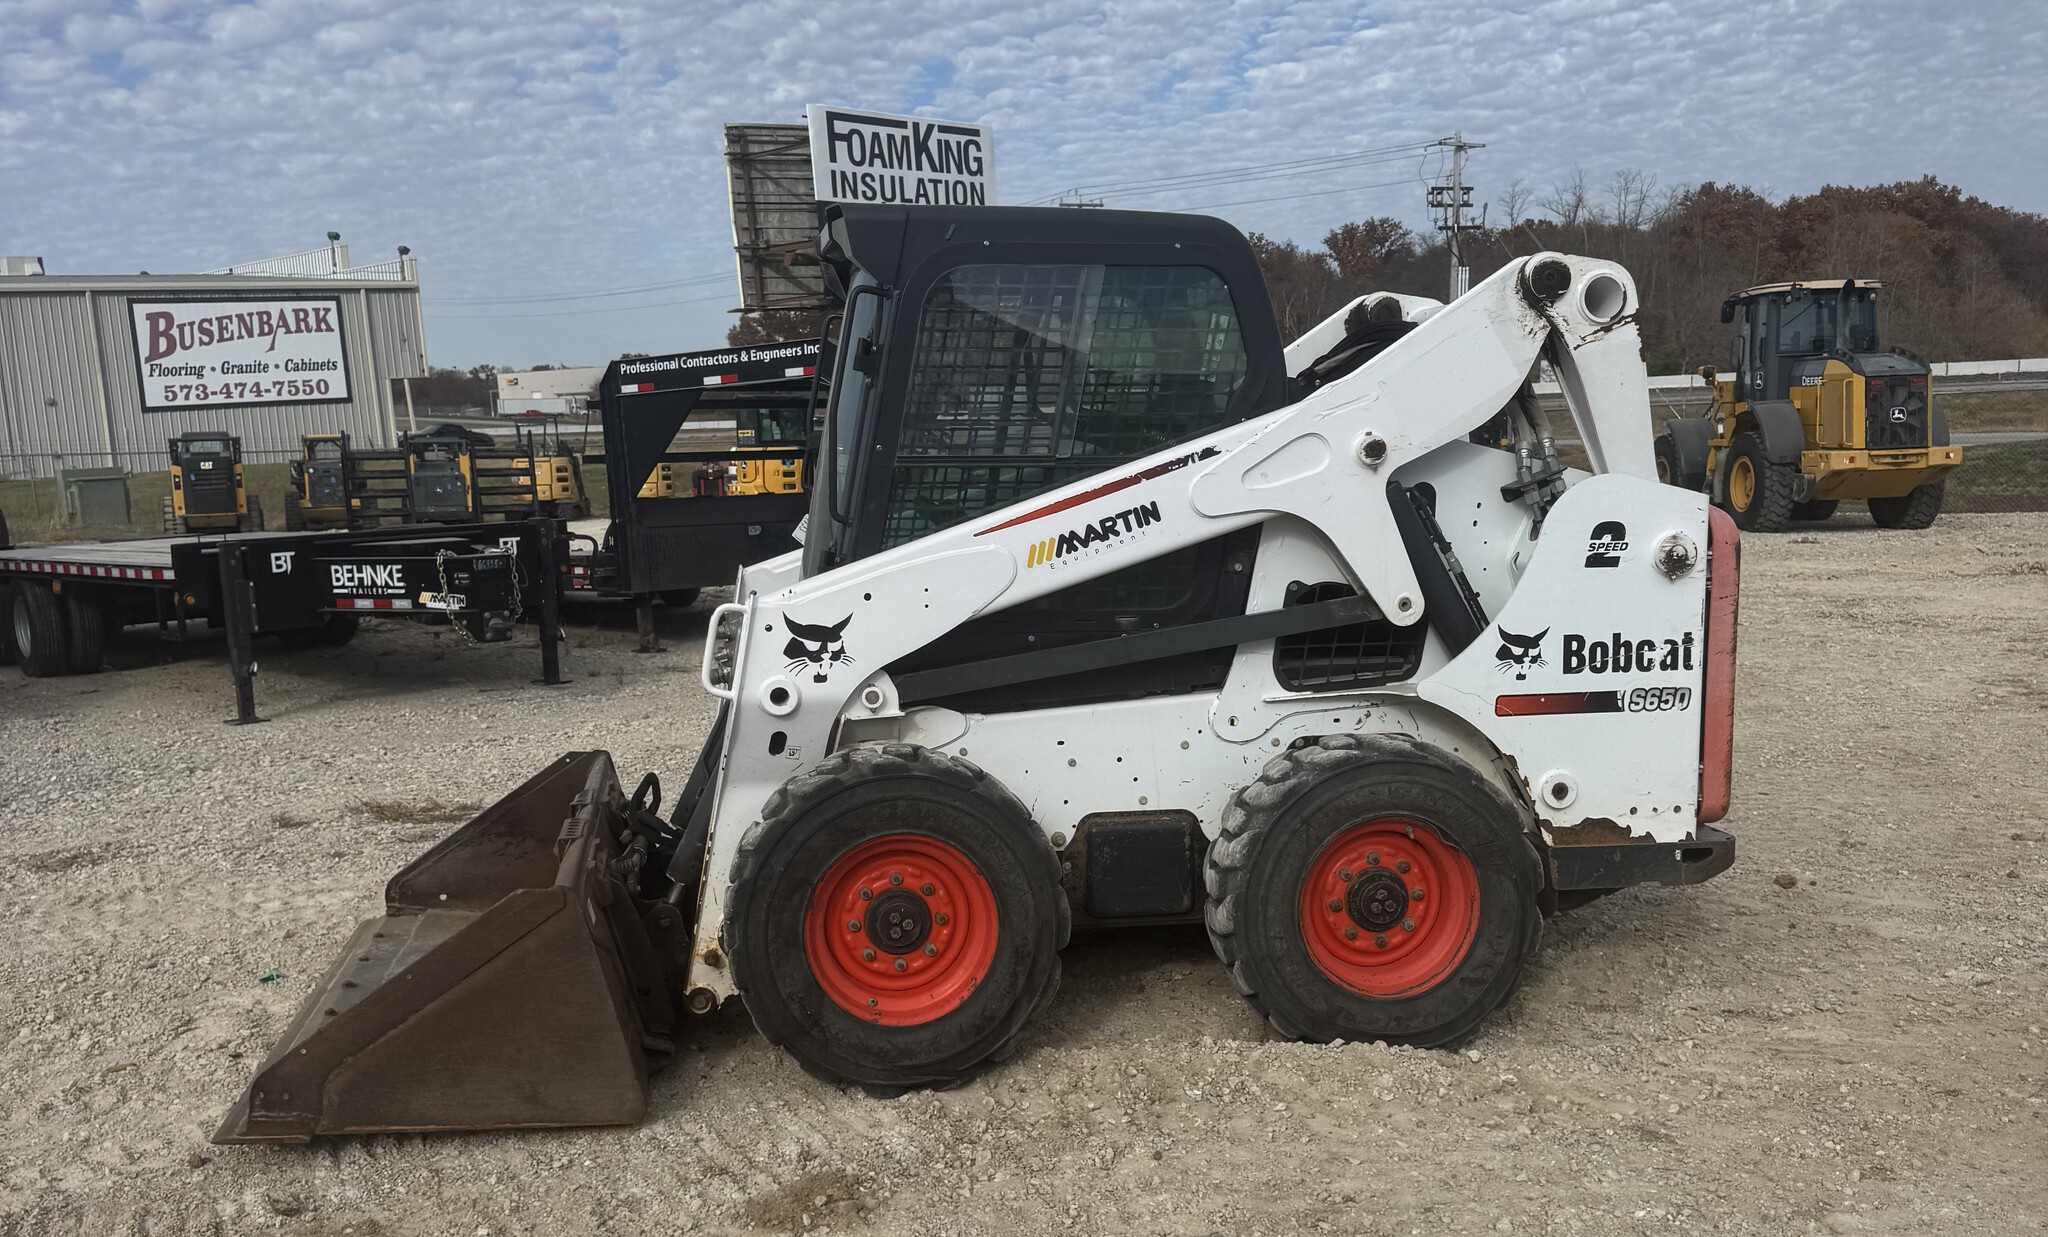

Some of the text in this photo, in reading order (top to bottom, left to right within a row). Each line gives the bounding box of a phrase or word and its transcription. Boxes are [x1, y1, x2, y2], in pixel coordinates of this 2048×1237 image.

[830, 169, 985, 206] INSULATION
[144, 307, 335, 364] BUSENBARK
[148, 358, 338, 379] Flooring Granite Cabinets
[620, 344, 820, 375] Professional Contractors & Engineers Inc
[163, 378, 330, 402] 573-474-7550
[1801, 375, 1823, 387] DEERE
[200, 461, 213, 470] CAT
[1055, 500, 1162, 558] MARTIN
[1049, 530, 1147, 570] Equipment
[1584, 520, 1627, 568] 2
[1587, 541, 1629, 552] SPEED
[270, 551, 296, 575] BT
[330, 564, 405, 587] BEHNKE
[348, 587, 388, 595] TRAILERS
[1562, 631, 1694, 675] Bobcat
[1628, 687, 1692, 713] S650
